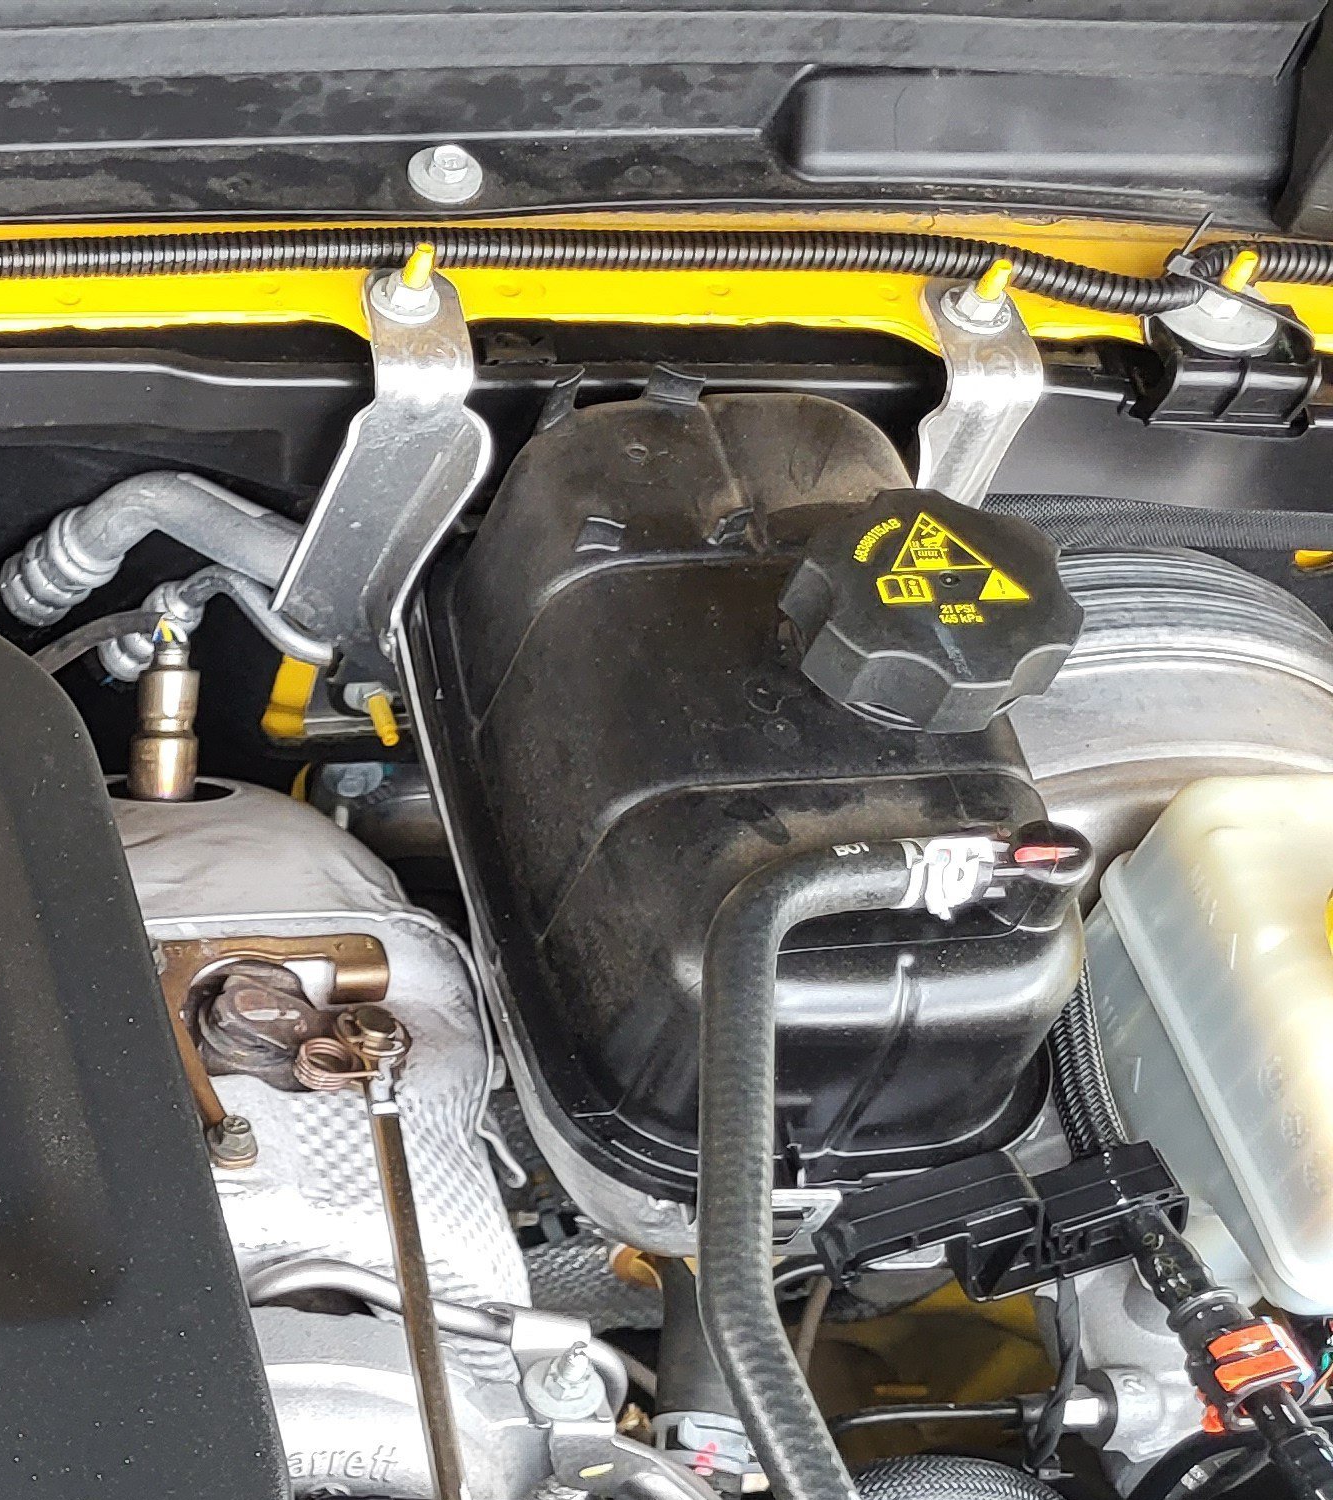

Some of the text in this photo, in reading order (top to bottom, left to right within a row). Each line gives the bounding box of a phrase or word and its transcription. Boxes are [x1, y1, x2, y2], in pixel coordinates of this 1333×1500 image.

[939, 603, 976, 614] 21 PSI
[938, 613, 984, 624] 145 kPa
[286, 1444, 399, 1483] arrett
